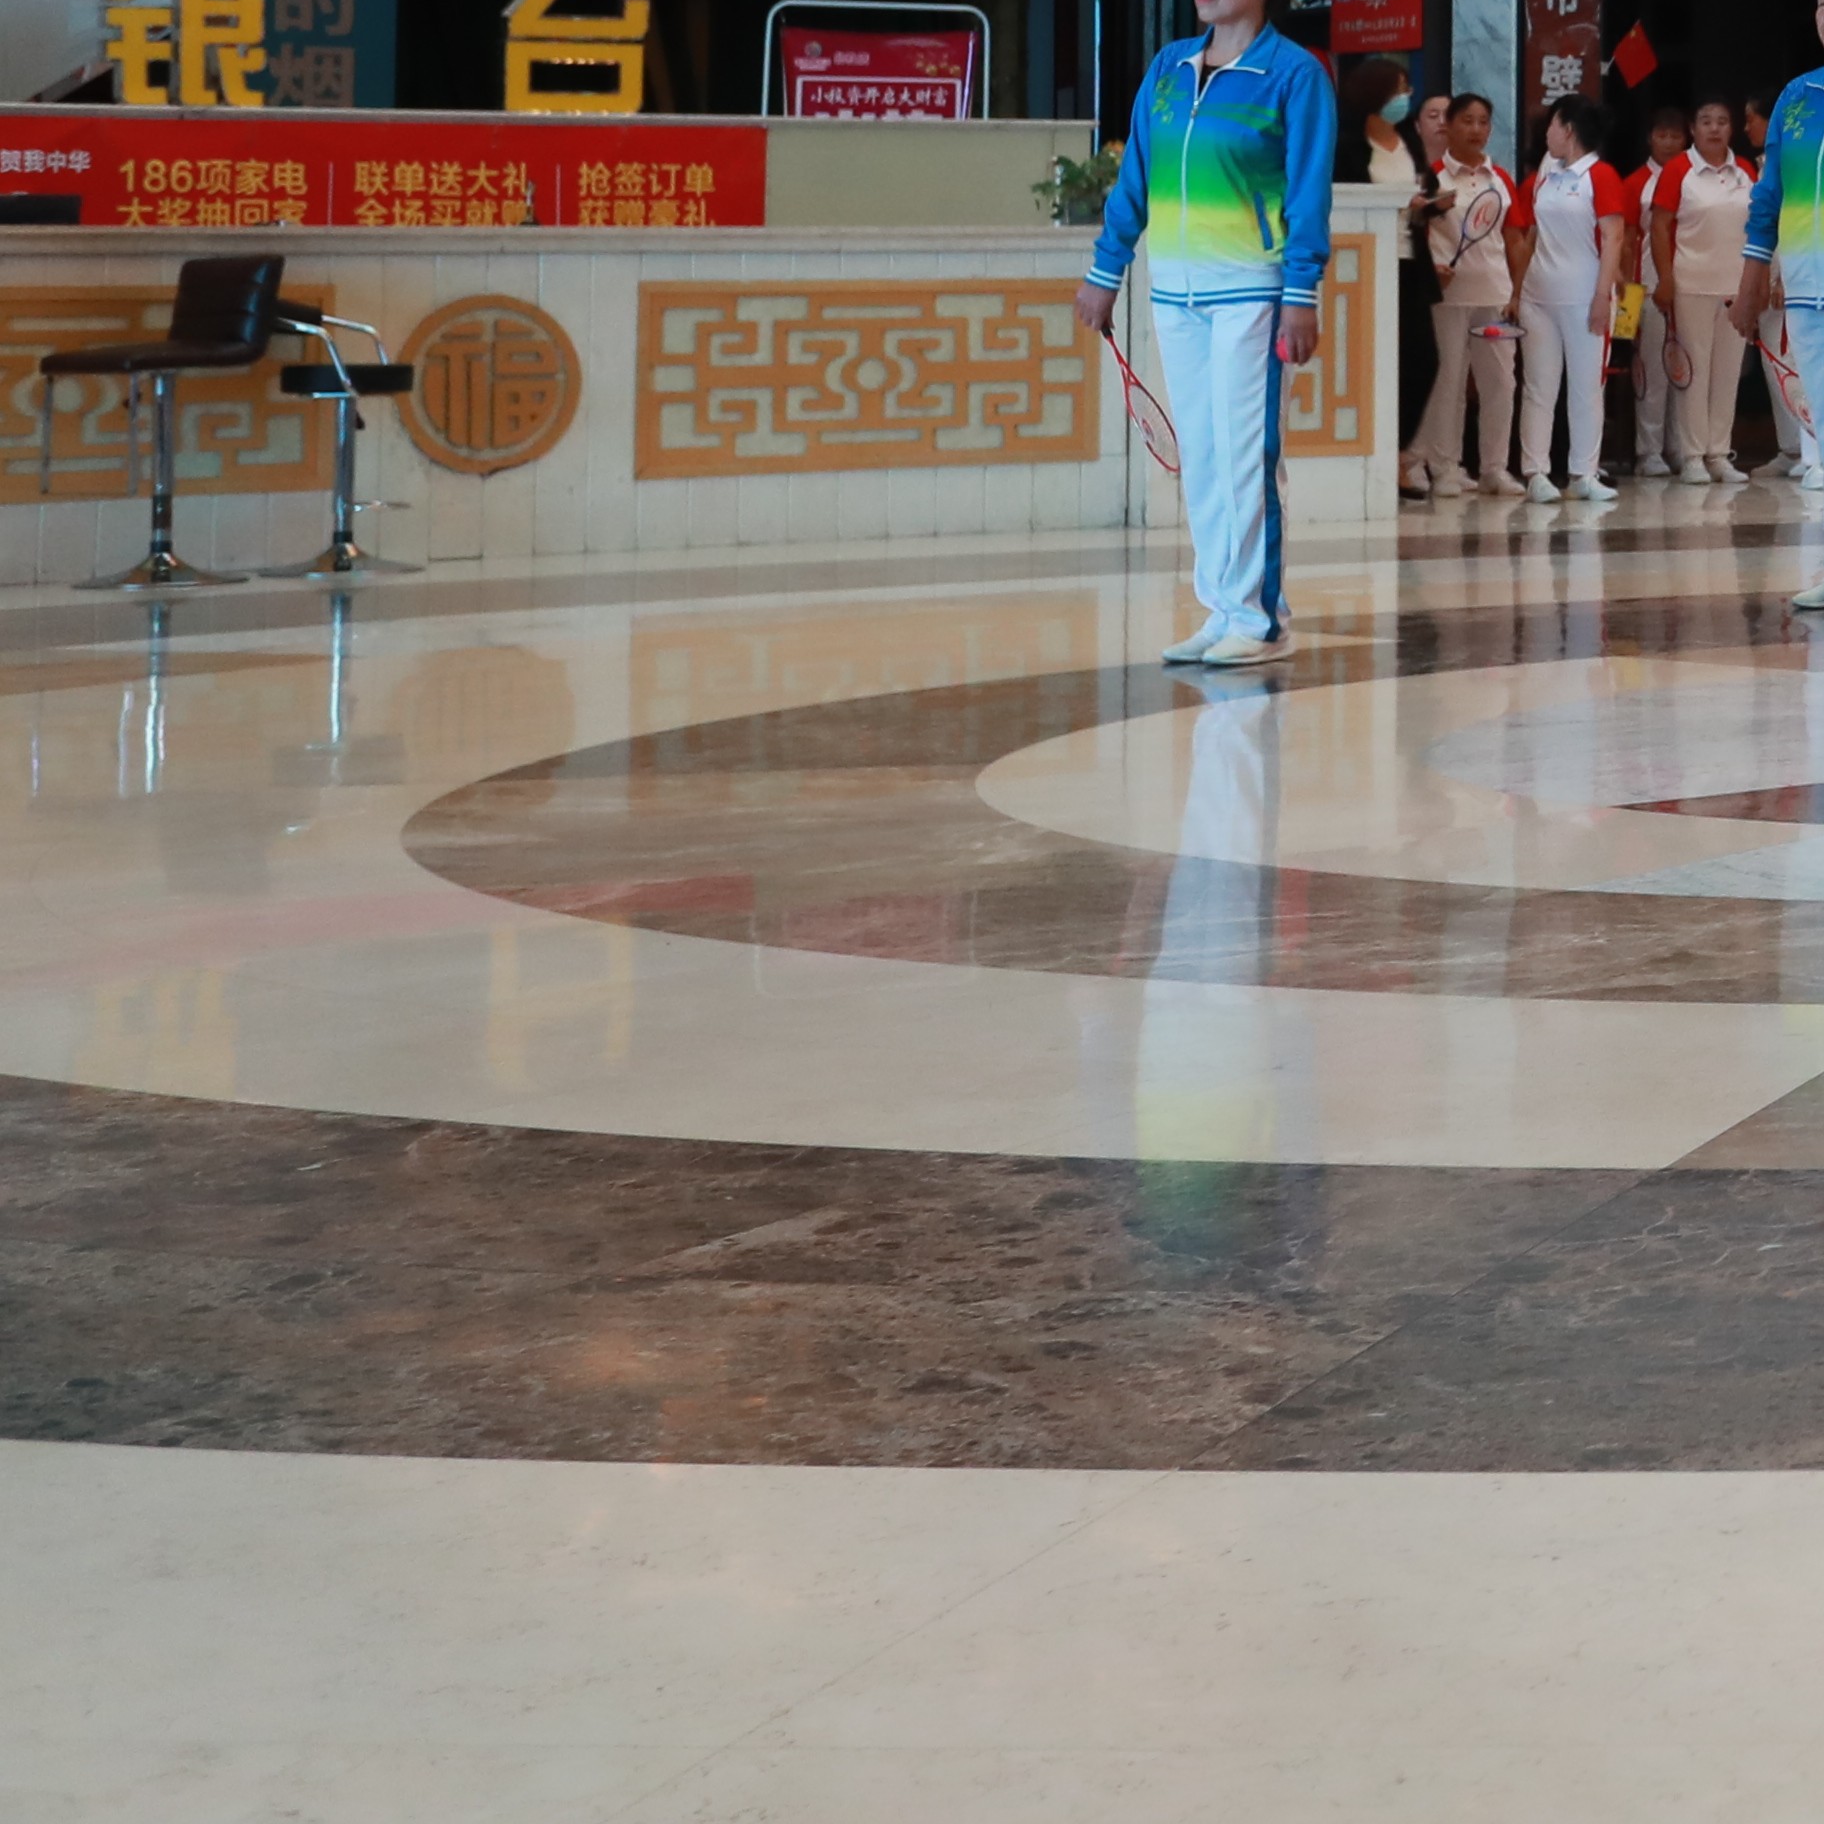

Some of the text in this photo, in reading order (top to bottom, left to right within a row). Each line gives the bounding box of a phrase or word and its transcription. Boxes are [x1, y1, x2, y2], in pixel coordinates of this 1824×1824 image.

[0, 148, 91, 174] 贺我中华
[118, 159, 716, 196] 186项家电 联单送大礼 抢签订单
[424, 318, 566, 452] 福
